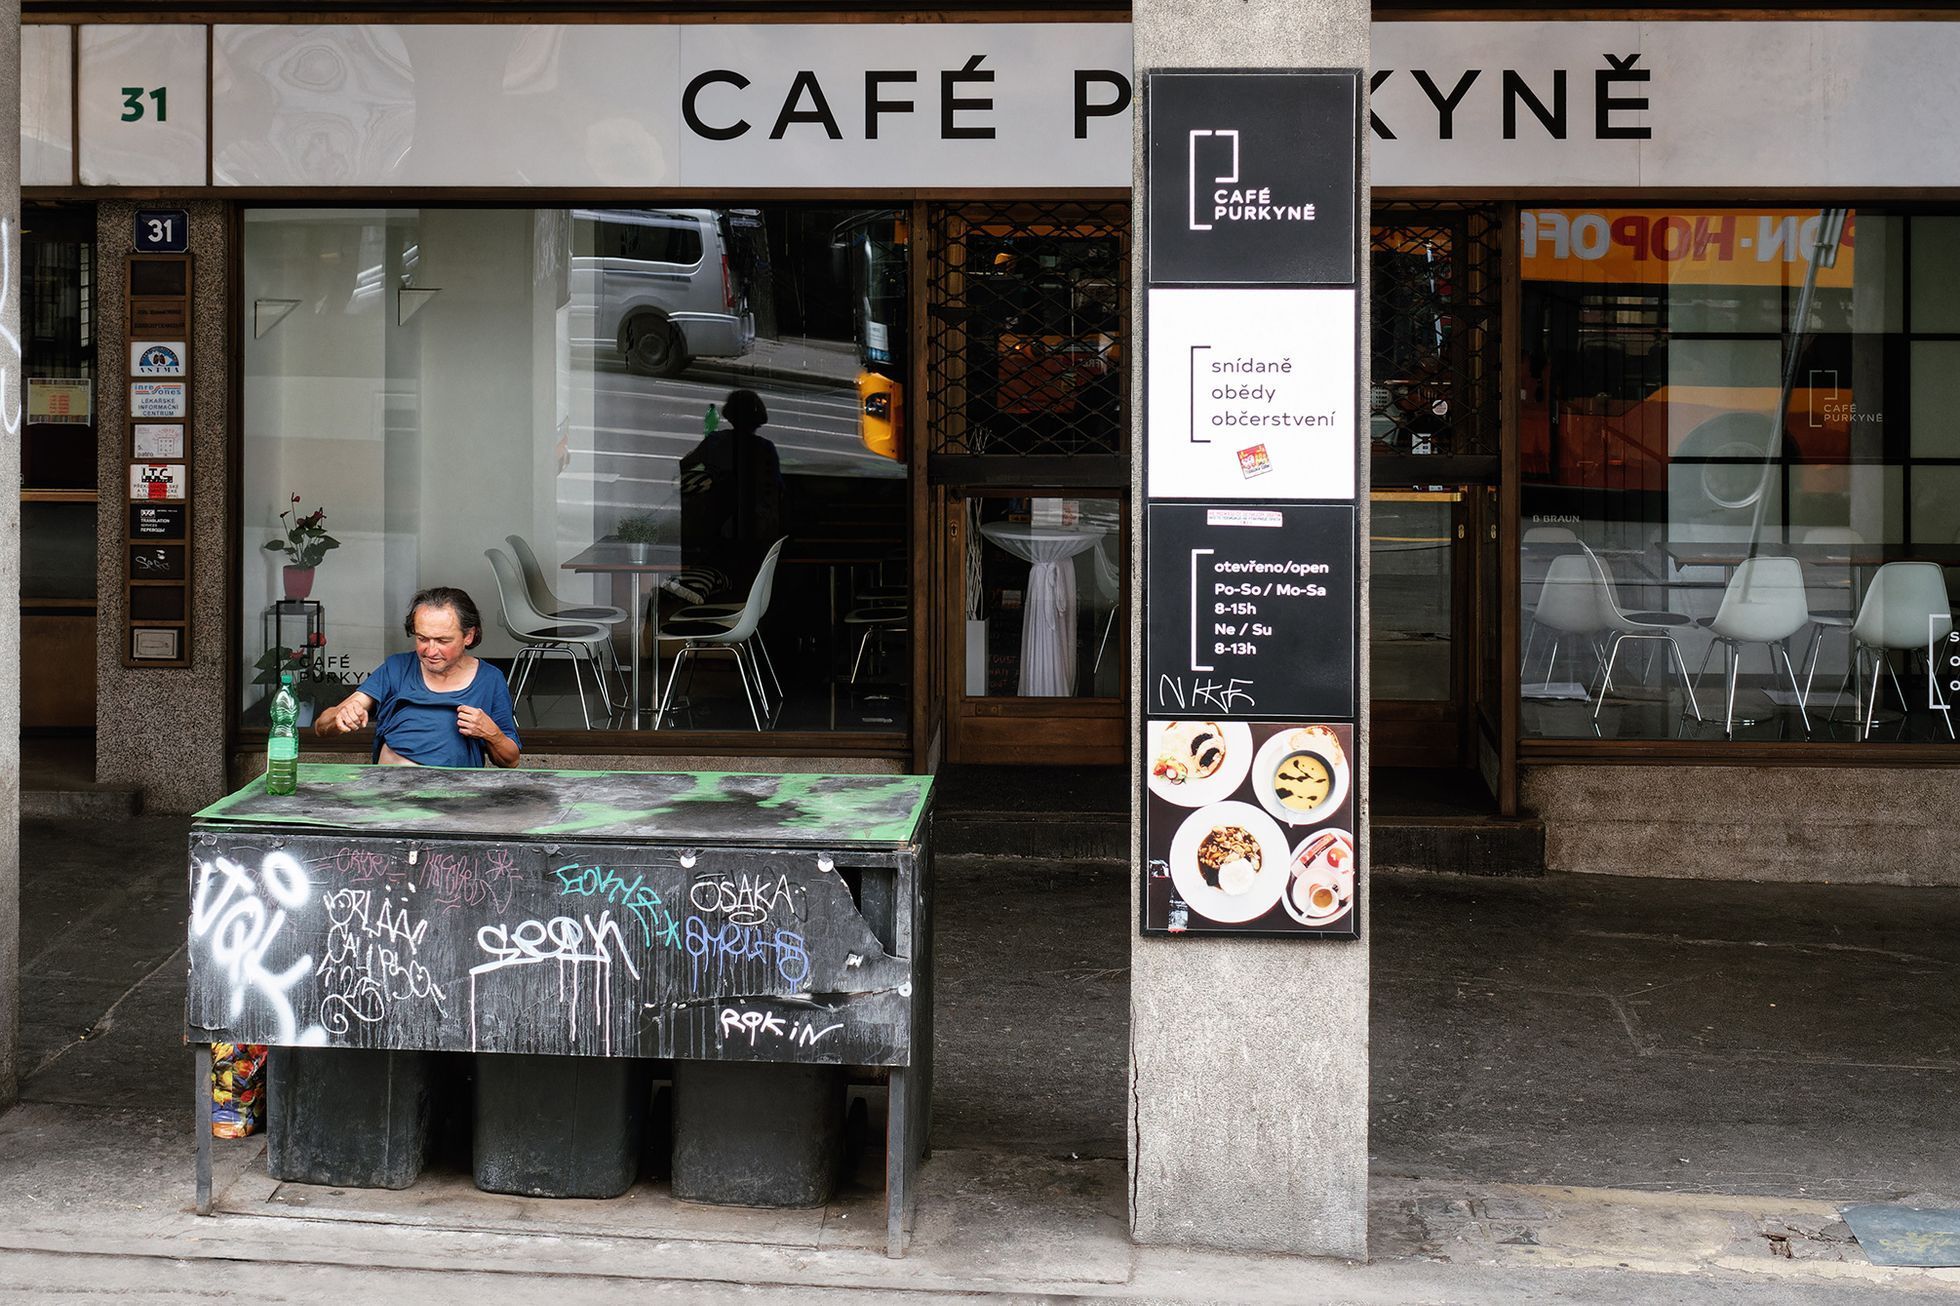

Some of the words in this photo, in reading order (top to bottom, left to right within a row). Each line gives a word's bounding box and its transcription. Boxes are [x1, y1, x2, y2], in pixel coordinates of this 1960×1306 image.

[682, 54, 996, 139] CAFÉ
[121, 87, 168, 122] 31
[1214, 187, 1271, 204] CAFÉ
[1214, 203, 1316, 220] PURKYNĚ
[147, 219, 173, 243] 31
[1211, 358, 1292, 373] snídaně
[1211, 384, 1276, 403] obědy
[1823, 403, 1857, 413] CAFÉ
[1211, 411, 1336, 426] občerstvení
[1823, 413, 1884, 423] PURKYNĚ
[1214, 560, 1330, 577] otevřeno/open
[1215, 584, 1261, 597] Po-So
[1276, 584, 1327, 598] Mo-Sa
[1214, 602, 1257, 616] 8-15h
[1215, 624, 1236, 637] Ne
[1252, 624, 1273, 637] Su
[1214, 643, 1257, 656] 8-13h
[300, 654, 351, 669] CAFÉ
